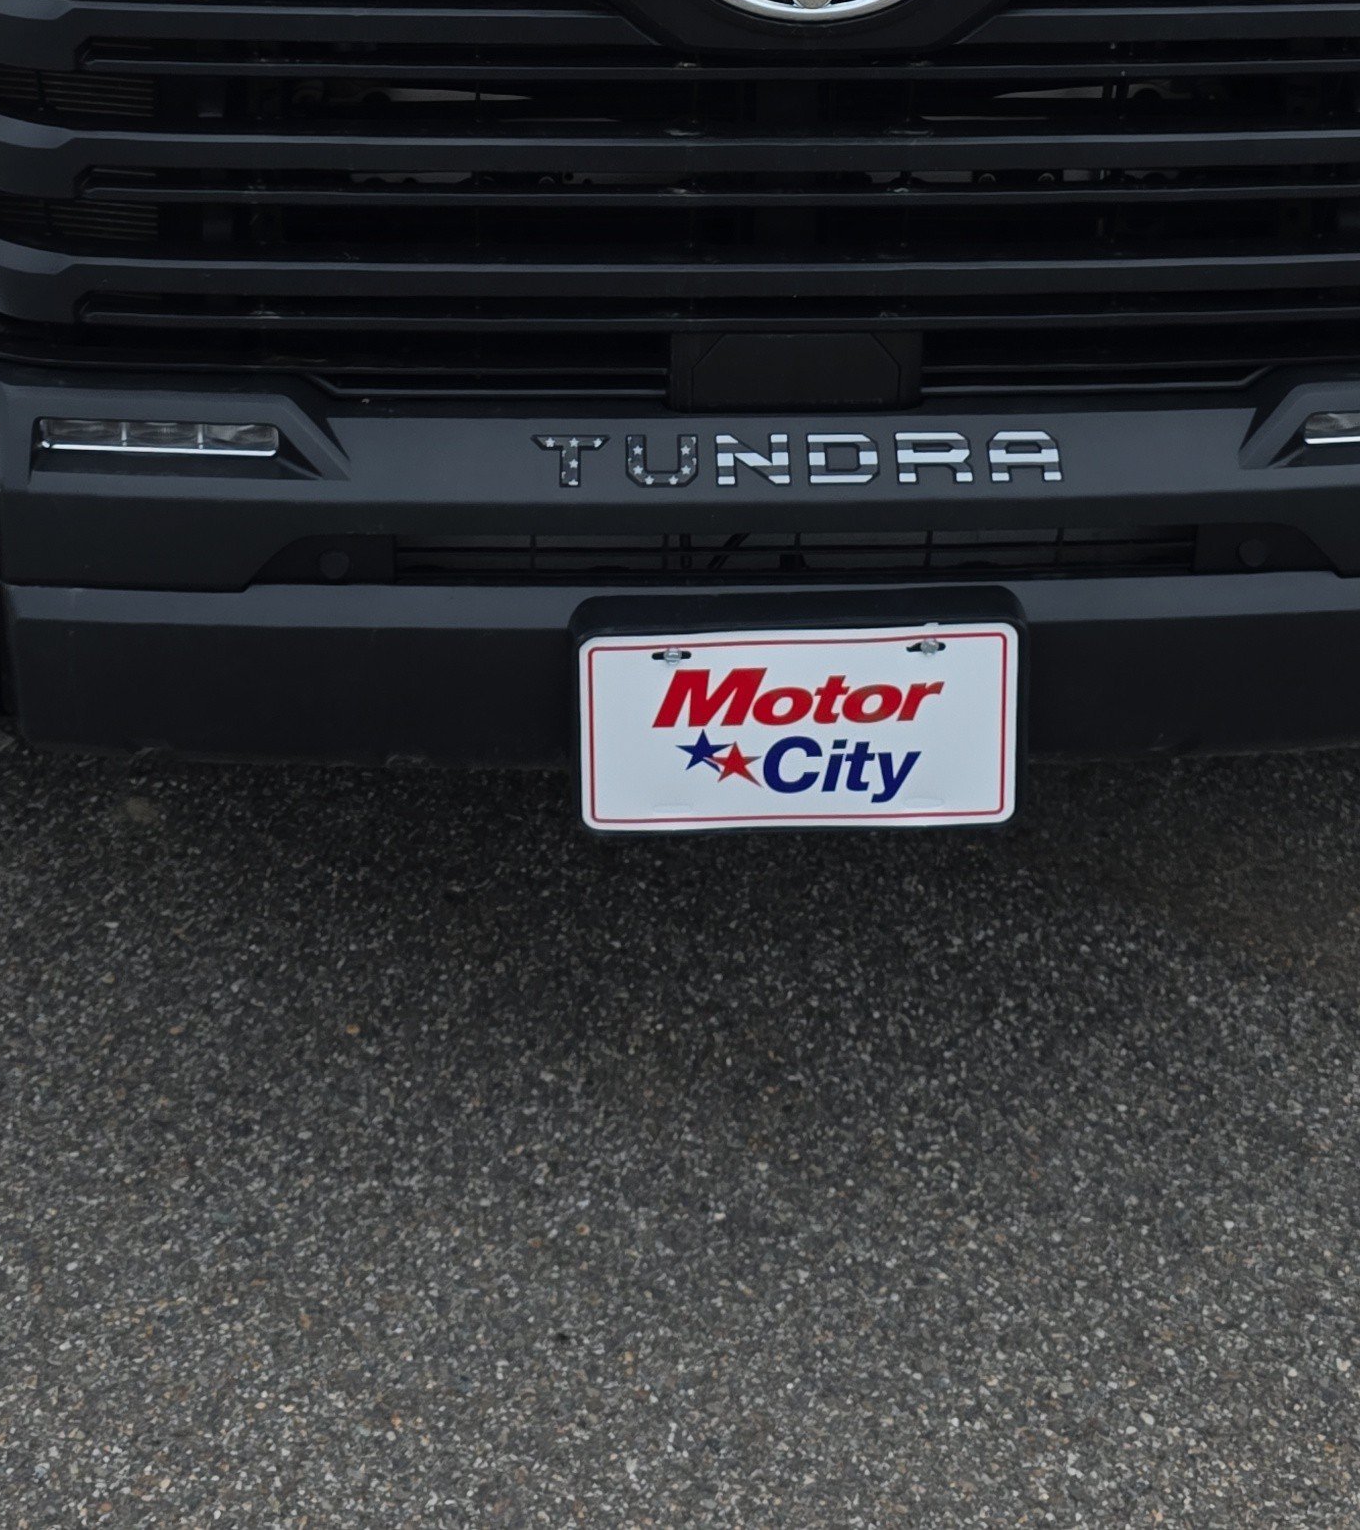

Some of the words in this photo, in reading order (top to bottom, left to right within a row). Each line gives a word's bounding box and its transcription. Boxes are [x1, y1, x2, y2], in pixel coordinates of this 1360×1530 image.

[532, 431, 1063, 488] TUNDRA
[652, 667, 944, 728] Motor
[762, 736, 921, 803] City
